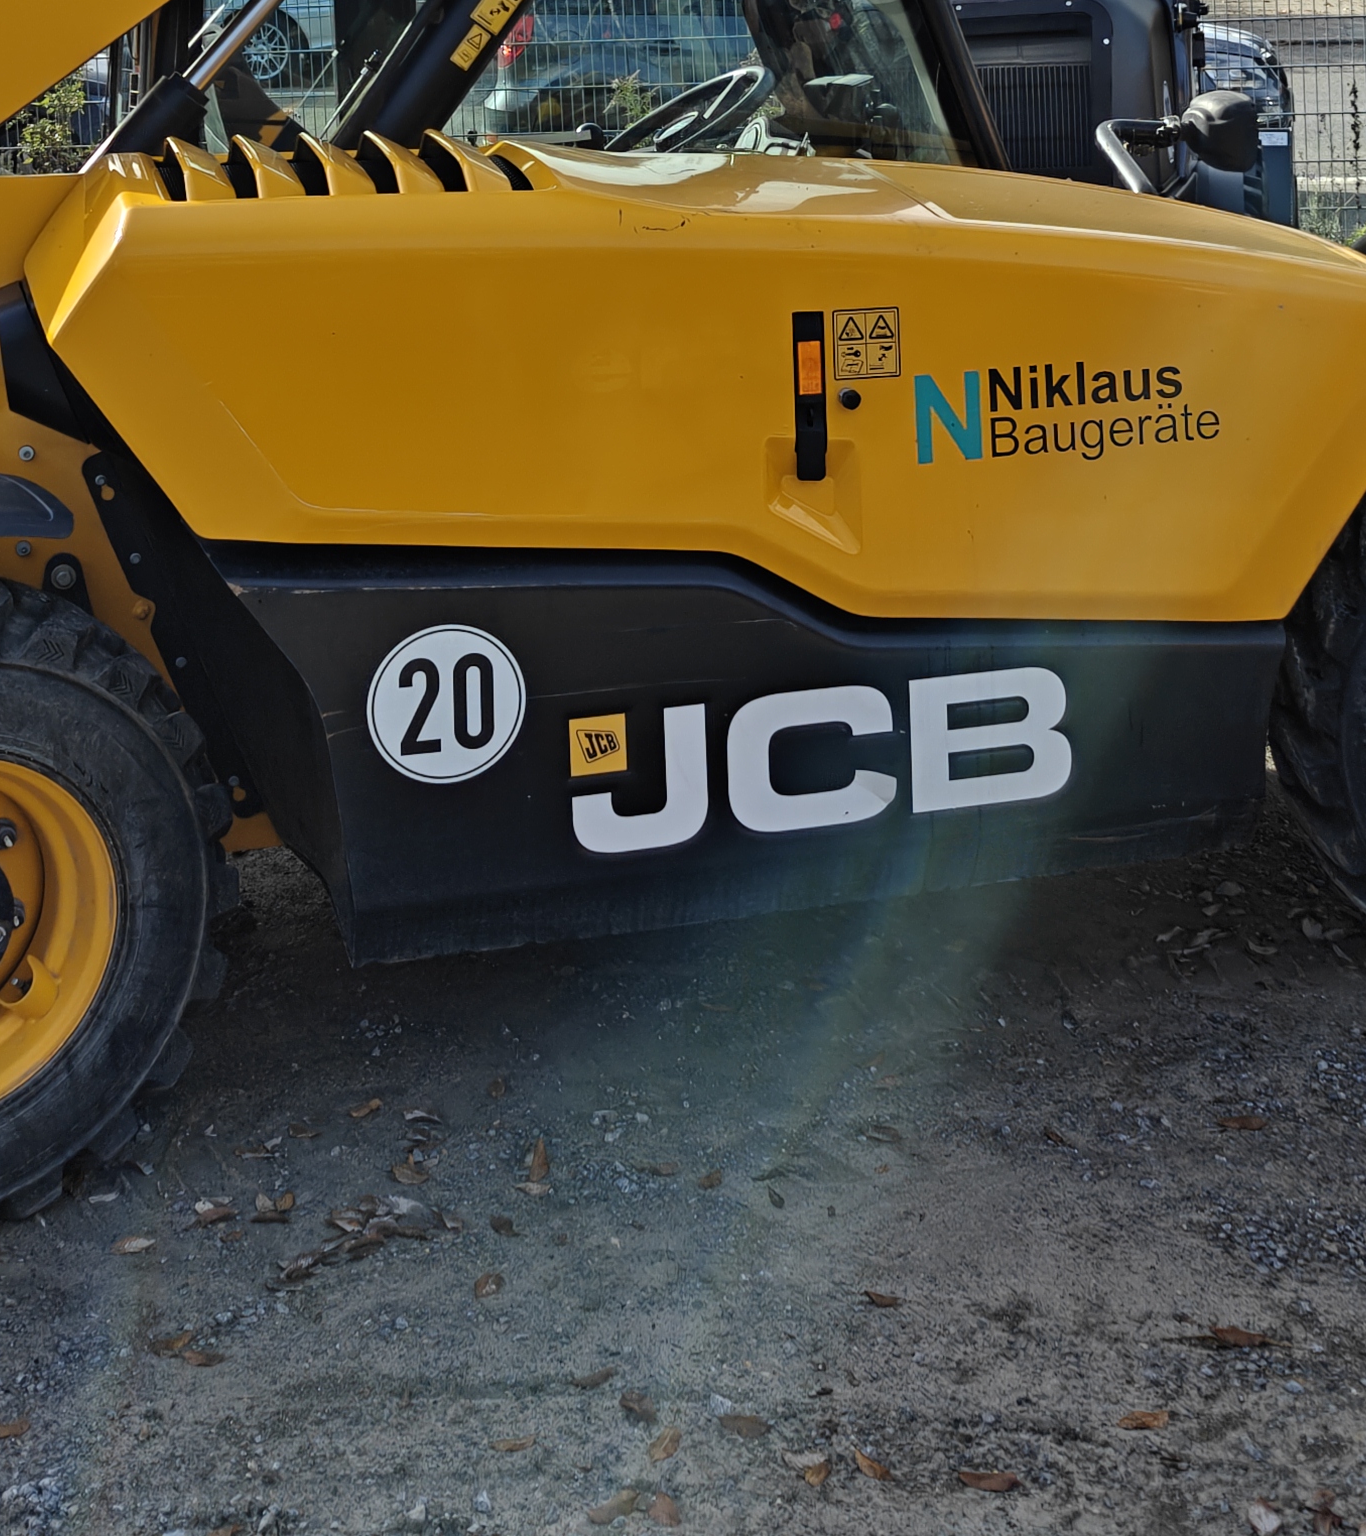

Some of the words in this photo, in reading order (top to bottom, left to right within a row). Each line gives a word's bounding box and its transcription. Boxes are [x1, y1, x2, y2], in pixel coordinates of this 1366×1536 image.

[914, 370, 984, 466] N
[988, 361, 1183, 413] Niklaus
[990, 402, 1221, 461] Baugeräte
[398, 652, 495, 757] 20
[571, 666, 1073, 854] JCB
[584, 732, 617, 760] JCB
